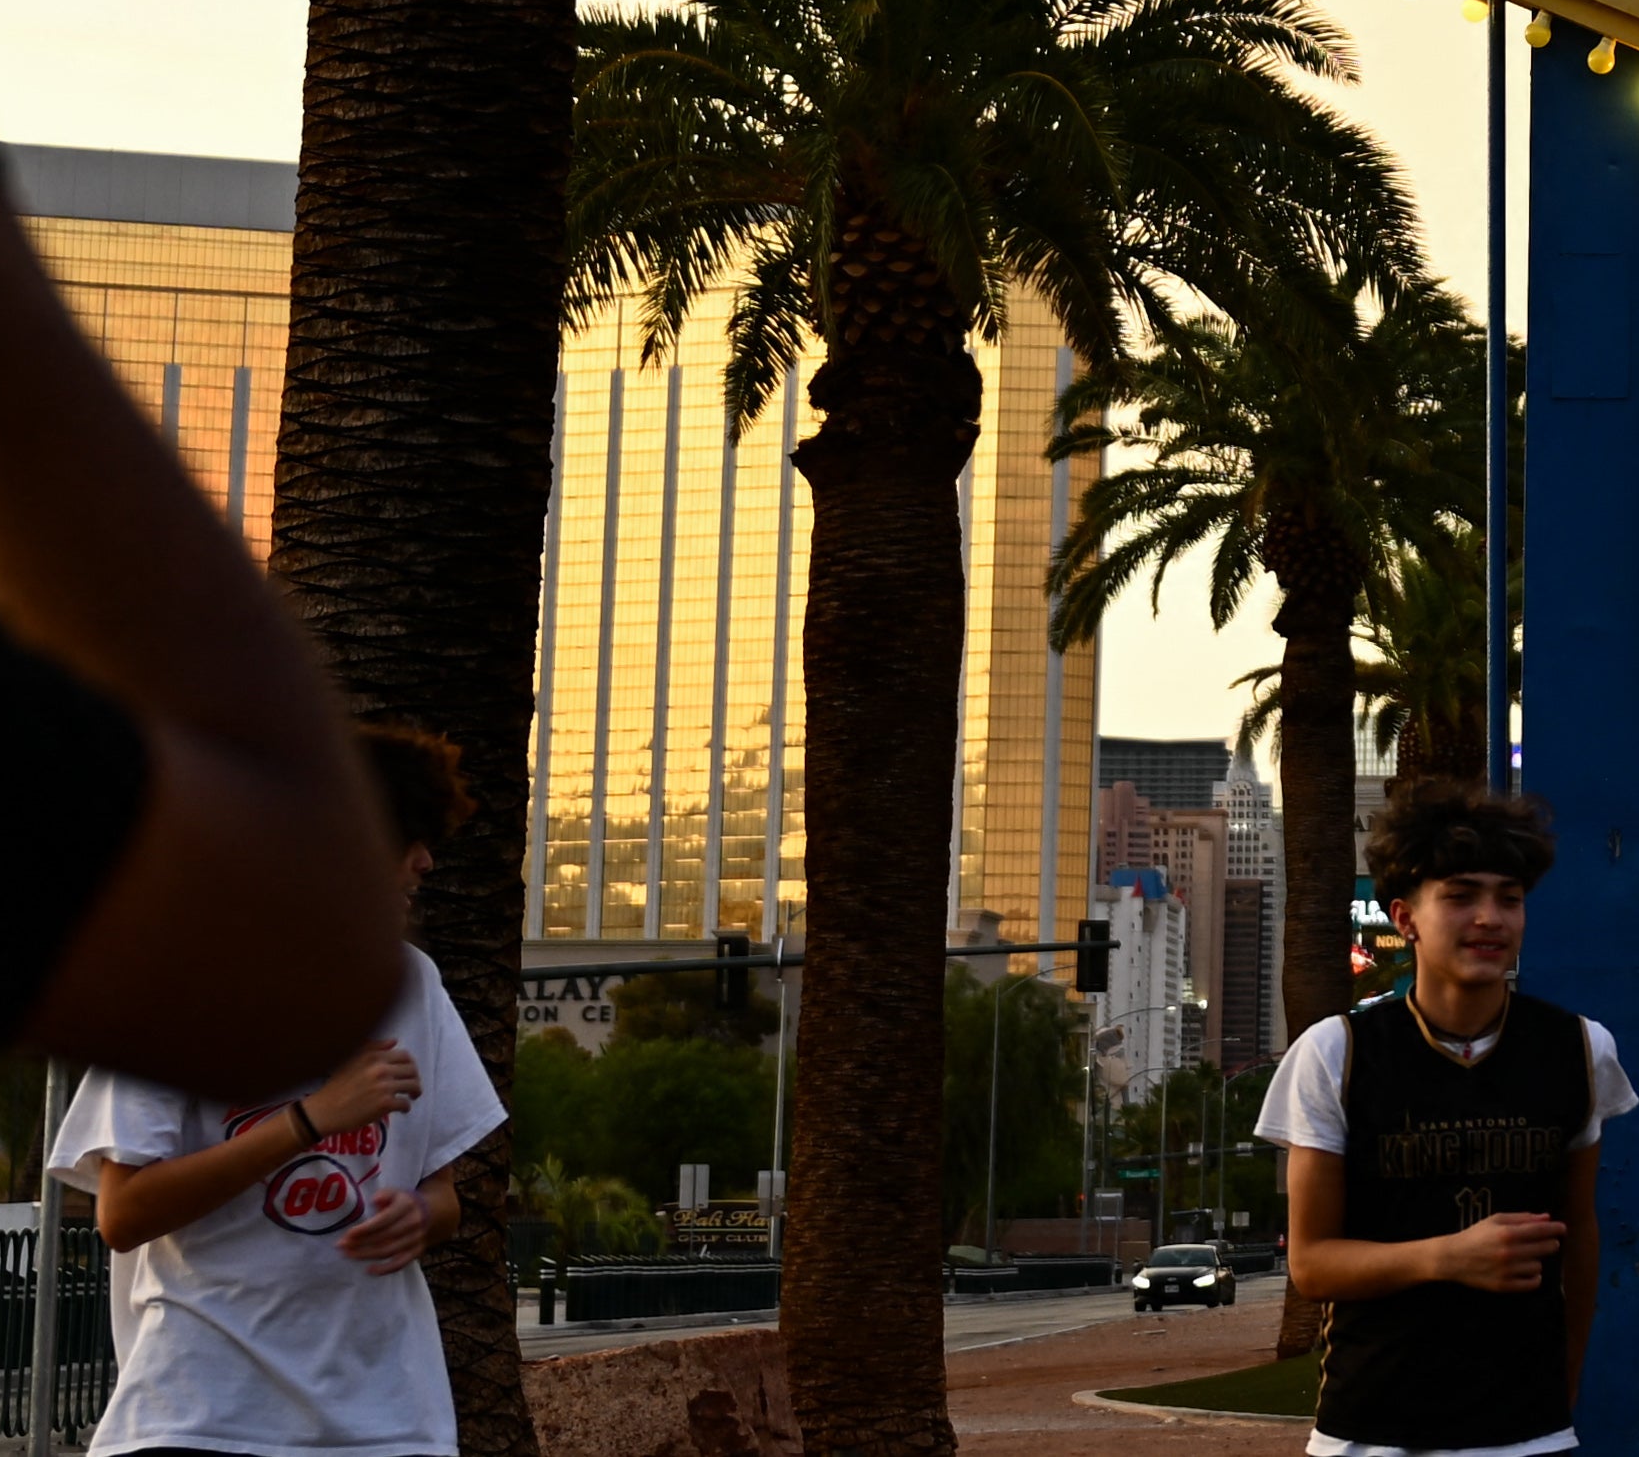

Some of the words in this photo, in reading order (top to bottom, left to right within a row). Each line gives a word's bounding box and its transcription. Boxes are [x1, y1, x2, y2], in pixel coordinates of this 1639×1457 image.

[1418, 1121, 1450, 1131] SAN
[1454, 1116, 1528, 1129] ANTONIO
[1378, 1131, 1461, 1179] KING
[283, 1171, 348, 1217] GO
[1454, 1186, 1493, 1231] 11
[725, 1209, 770, 1227] Ha
